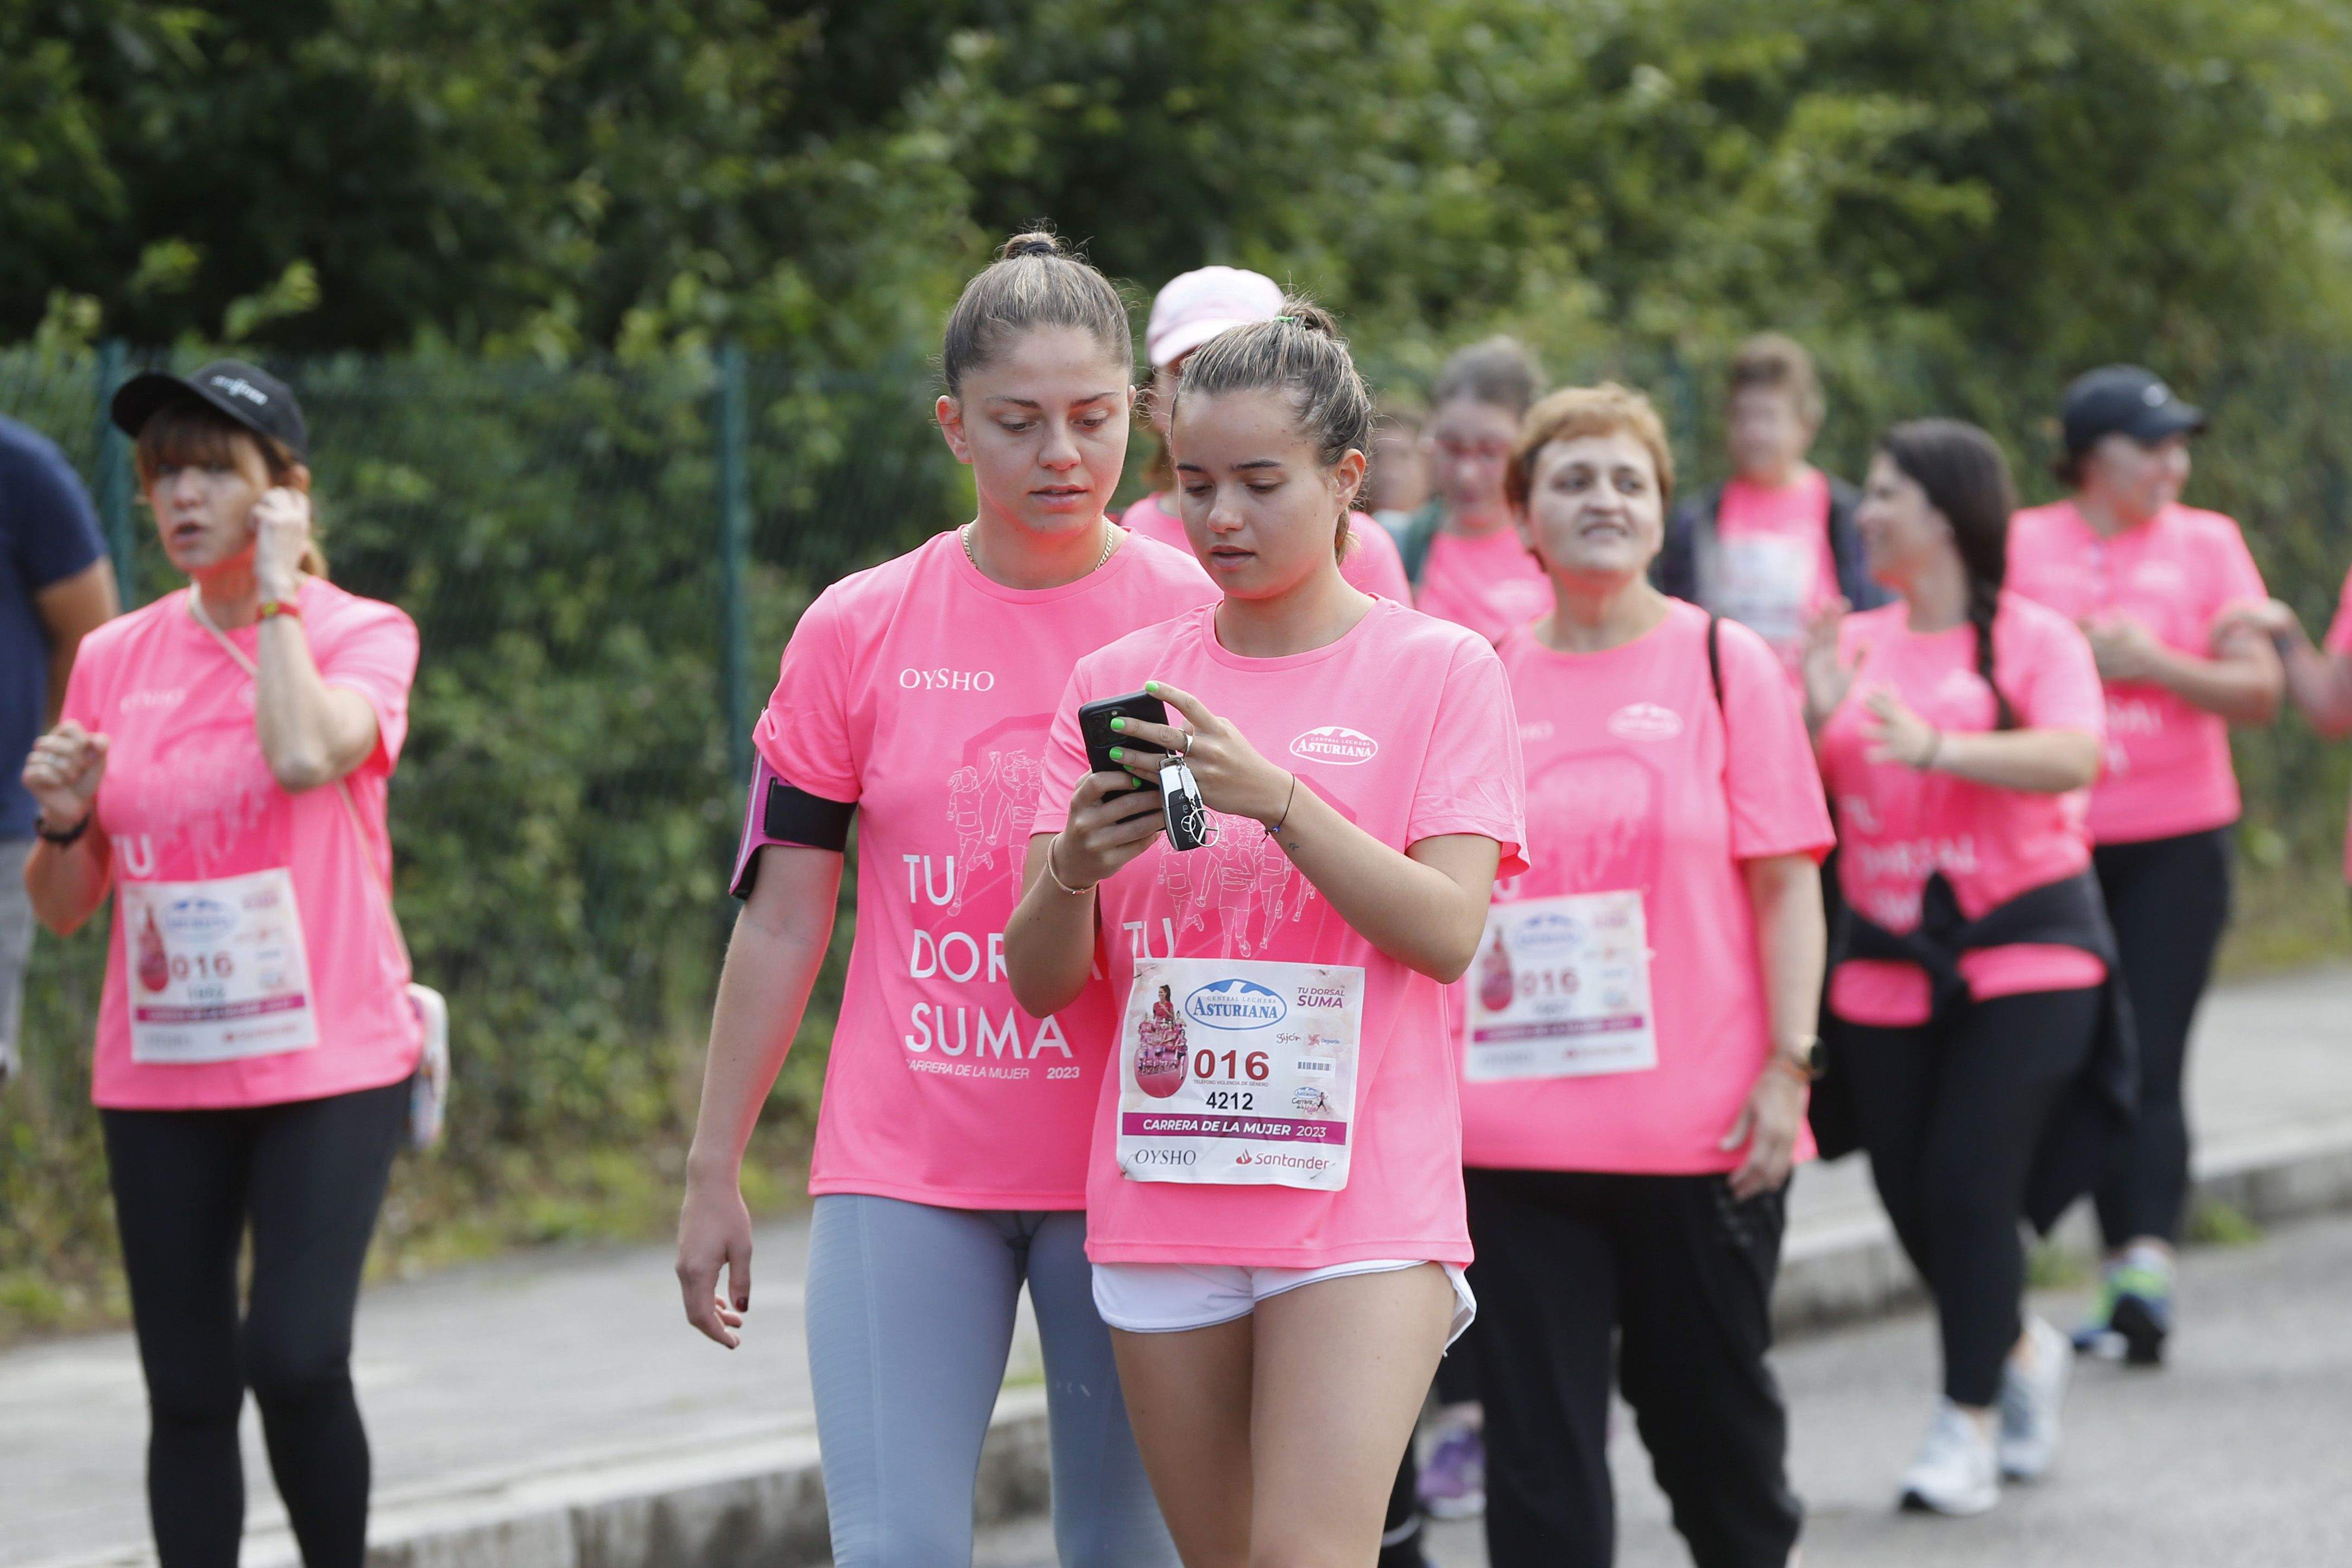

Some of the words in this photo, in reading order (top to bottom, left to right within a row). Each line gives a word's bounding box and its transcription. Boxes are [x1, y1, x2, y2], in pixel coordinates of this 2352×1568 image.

[899, 668, 995, 692] OYSHO
[1295, 739, 1371, 757] ASTURIANA
[902, 854, 955, 906] TU
[1123, 917, 1174, 958] TU
[1297, 995, 1343, 1008] SUMA
[1311, 988, 1345, 996] DORSAL
[1193, 996, 1278, 1019] ASTURIANA
[905, 1002, 1073, 1059] SUMA
[906, 1059, 951, 1074] ARRERA
[954, 1065, 972, 1077] DE
[972, 1066, 987, 1077] LA
[988, 1068, 1030, 1080] MUJER
[1046, 1066, 1080, 1080] 2023
[1194, 1049, 1269, 1080] 016
[1205, 1091, 1254, 1110] 4212
[1143, 1119, 1198, 1131] CARRERA
[1201, 1120, 1219, 1132] DE
[1222, 1122, 1240, 1133] LA
[1243, 1123, 1291, 1136] MUJER
[1296, 1126, 1327, 1138] 2023
[1135, 1149, 1196, 1166] OYSHO
[1255, 1153, 1330, 1170] Santander
